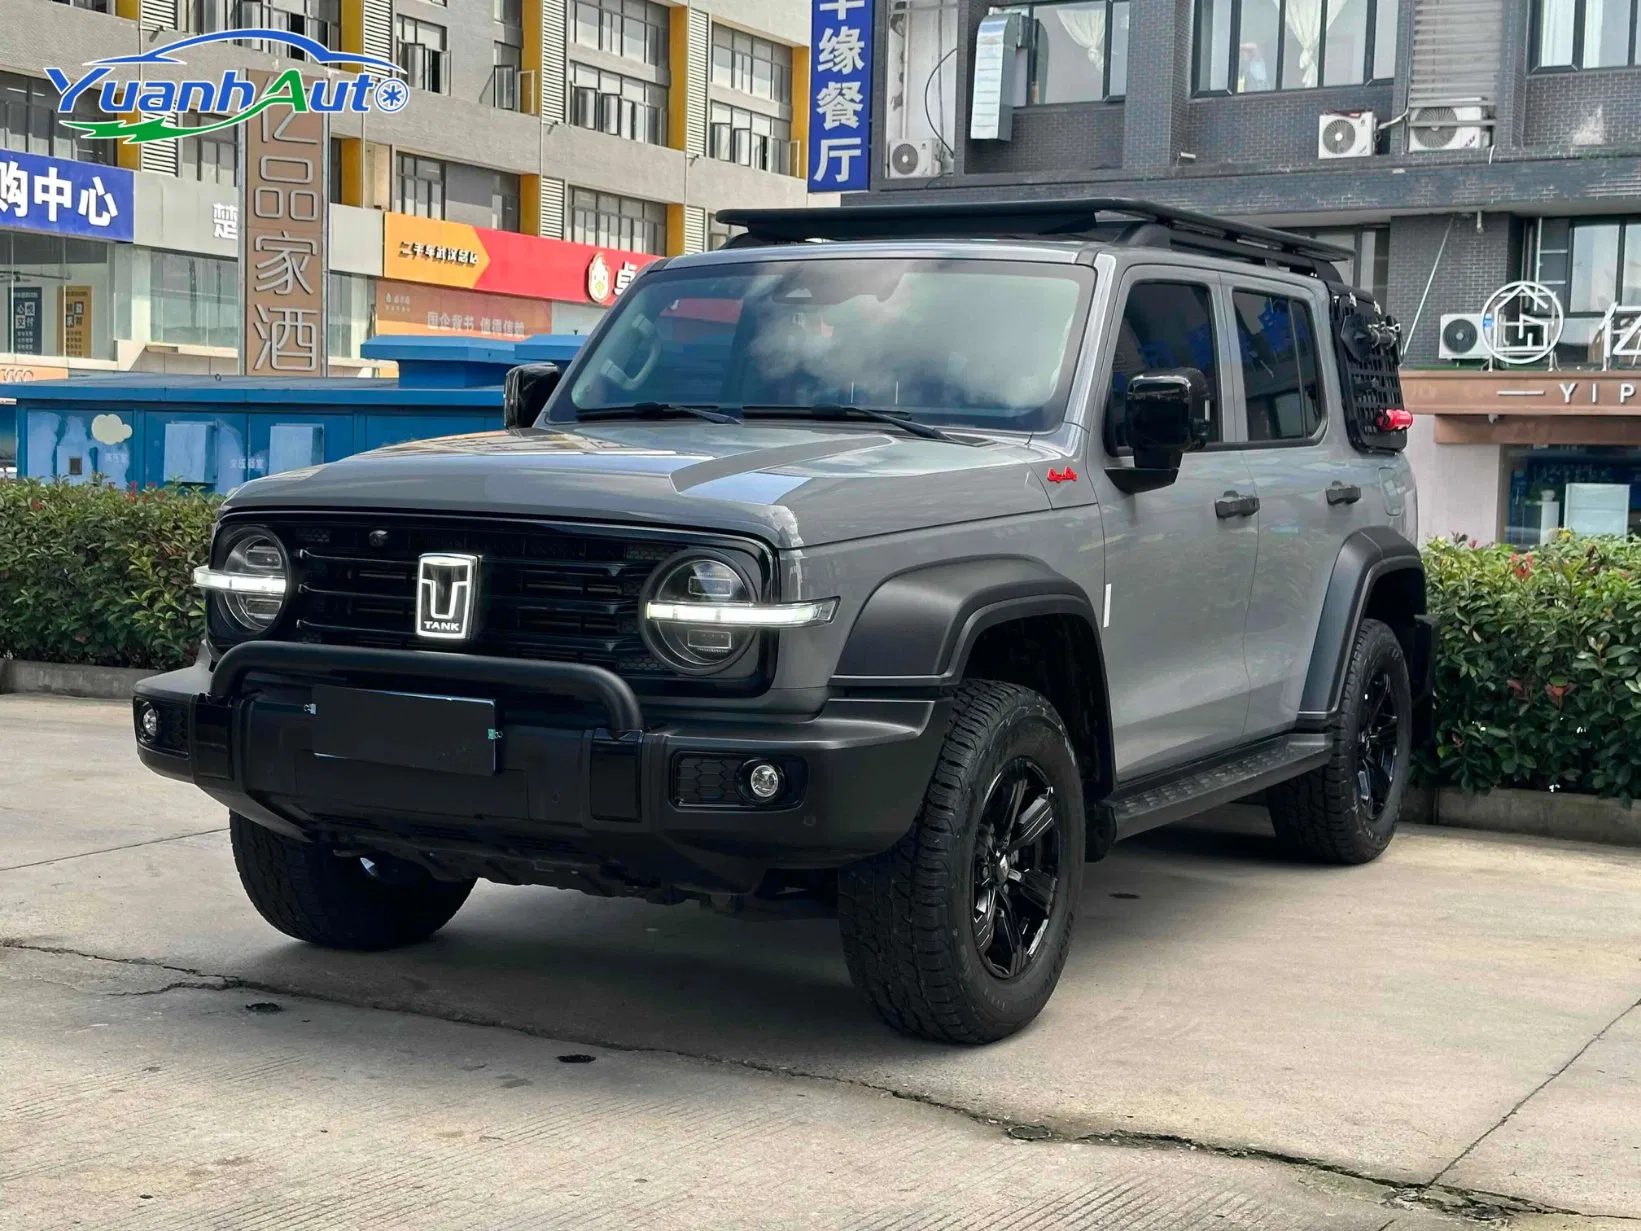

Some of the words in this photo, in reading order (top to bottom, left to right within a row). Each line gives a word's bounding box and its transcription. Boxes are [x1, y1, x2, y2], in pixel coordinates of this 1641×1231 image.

[0, 161, 119, 227] 购中心
[427, 311, 475, 332] 国企背书
[1559, 383, 1637, 404] YIP
[424, 620, 460, 632] TANK
